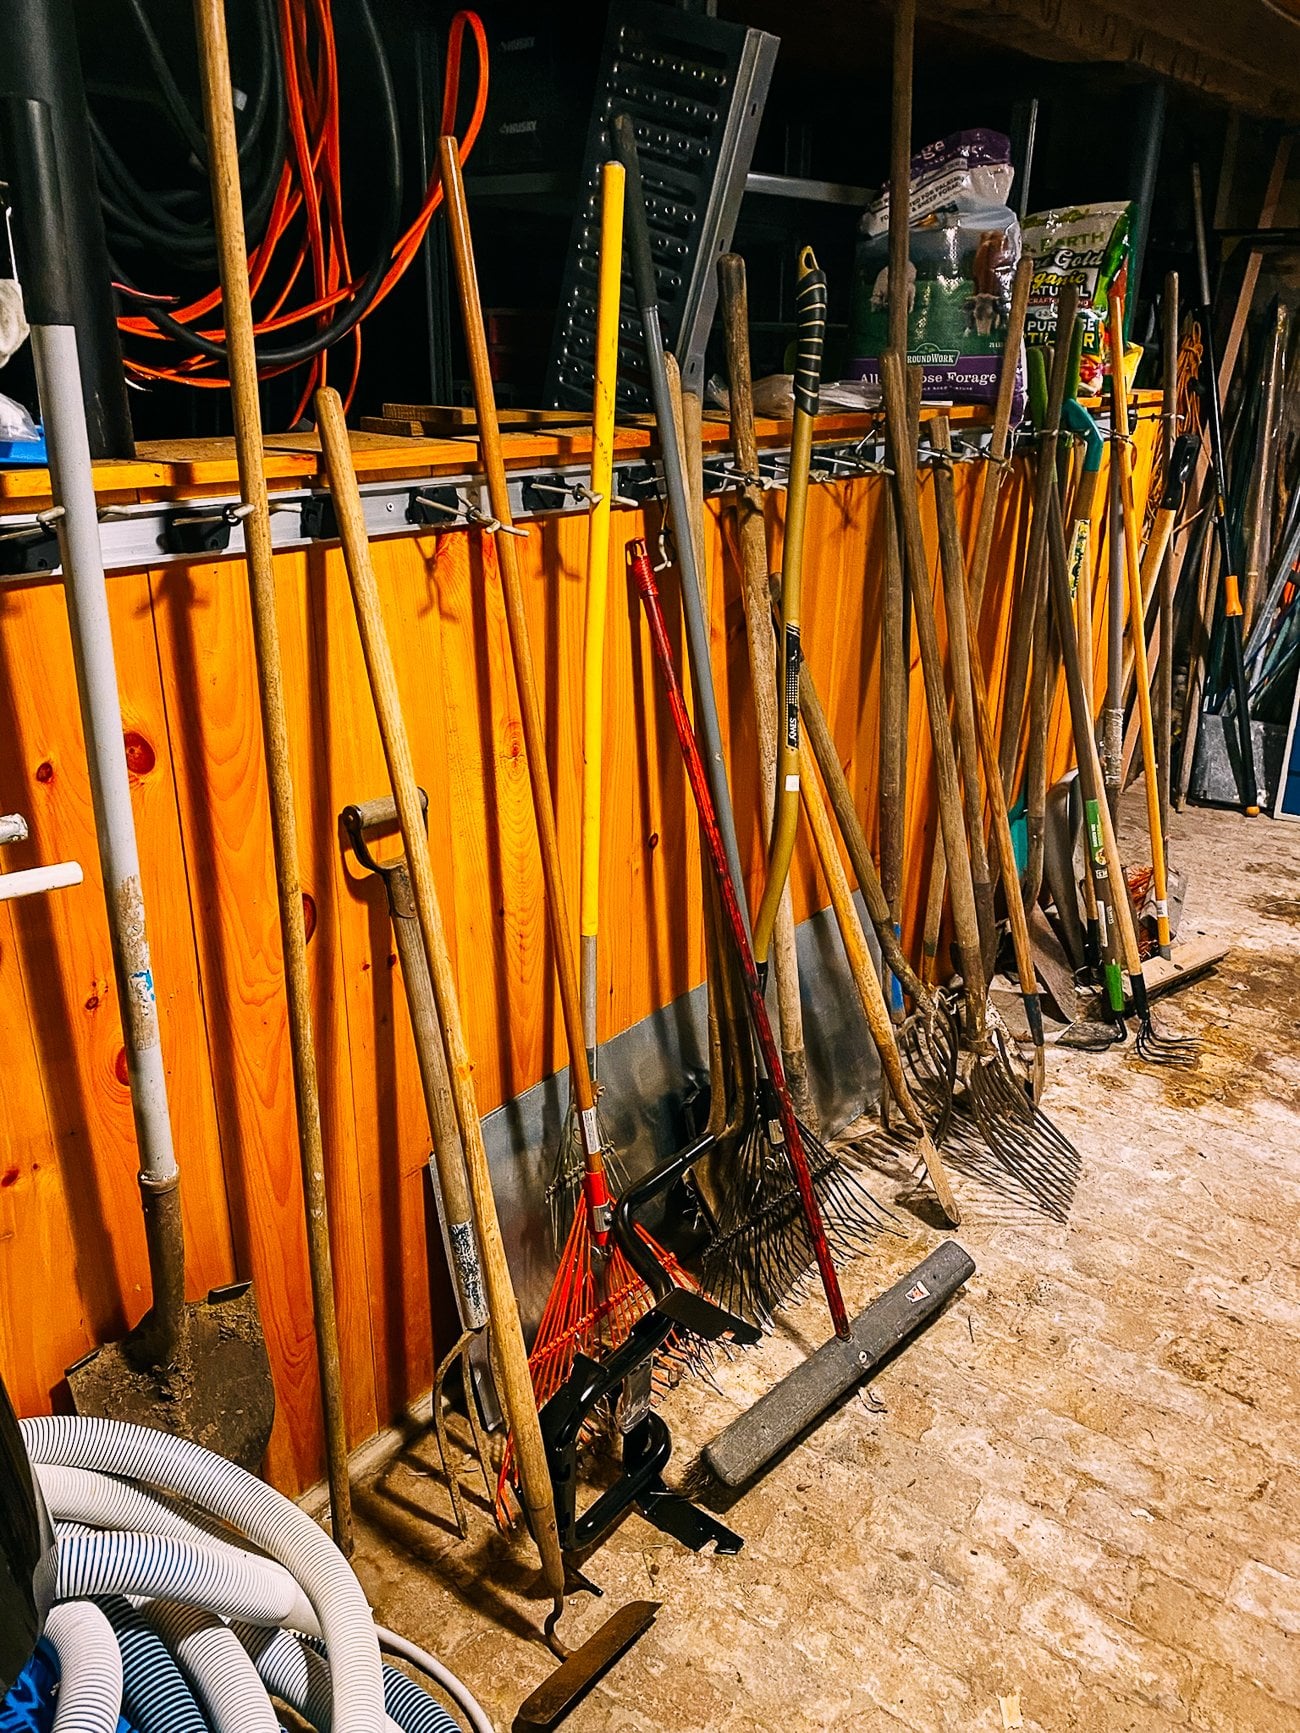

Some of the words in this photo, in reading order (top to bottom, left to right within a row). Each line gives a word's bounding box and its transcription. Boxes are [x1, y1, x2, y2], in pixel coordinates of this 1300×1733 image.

[506, 121, 537, 133] HUSKY
[1040, 231, 1104, 251] EARTH
[1054, 248, 1105, 270] Gold
[946, 372, 997, 386] Forage
